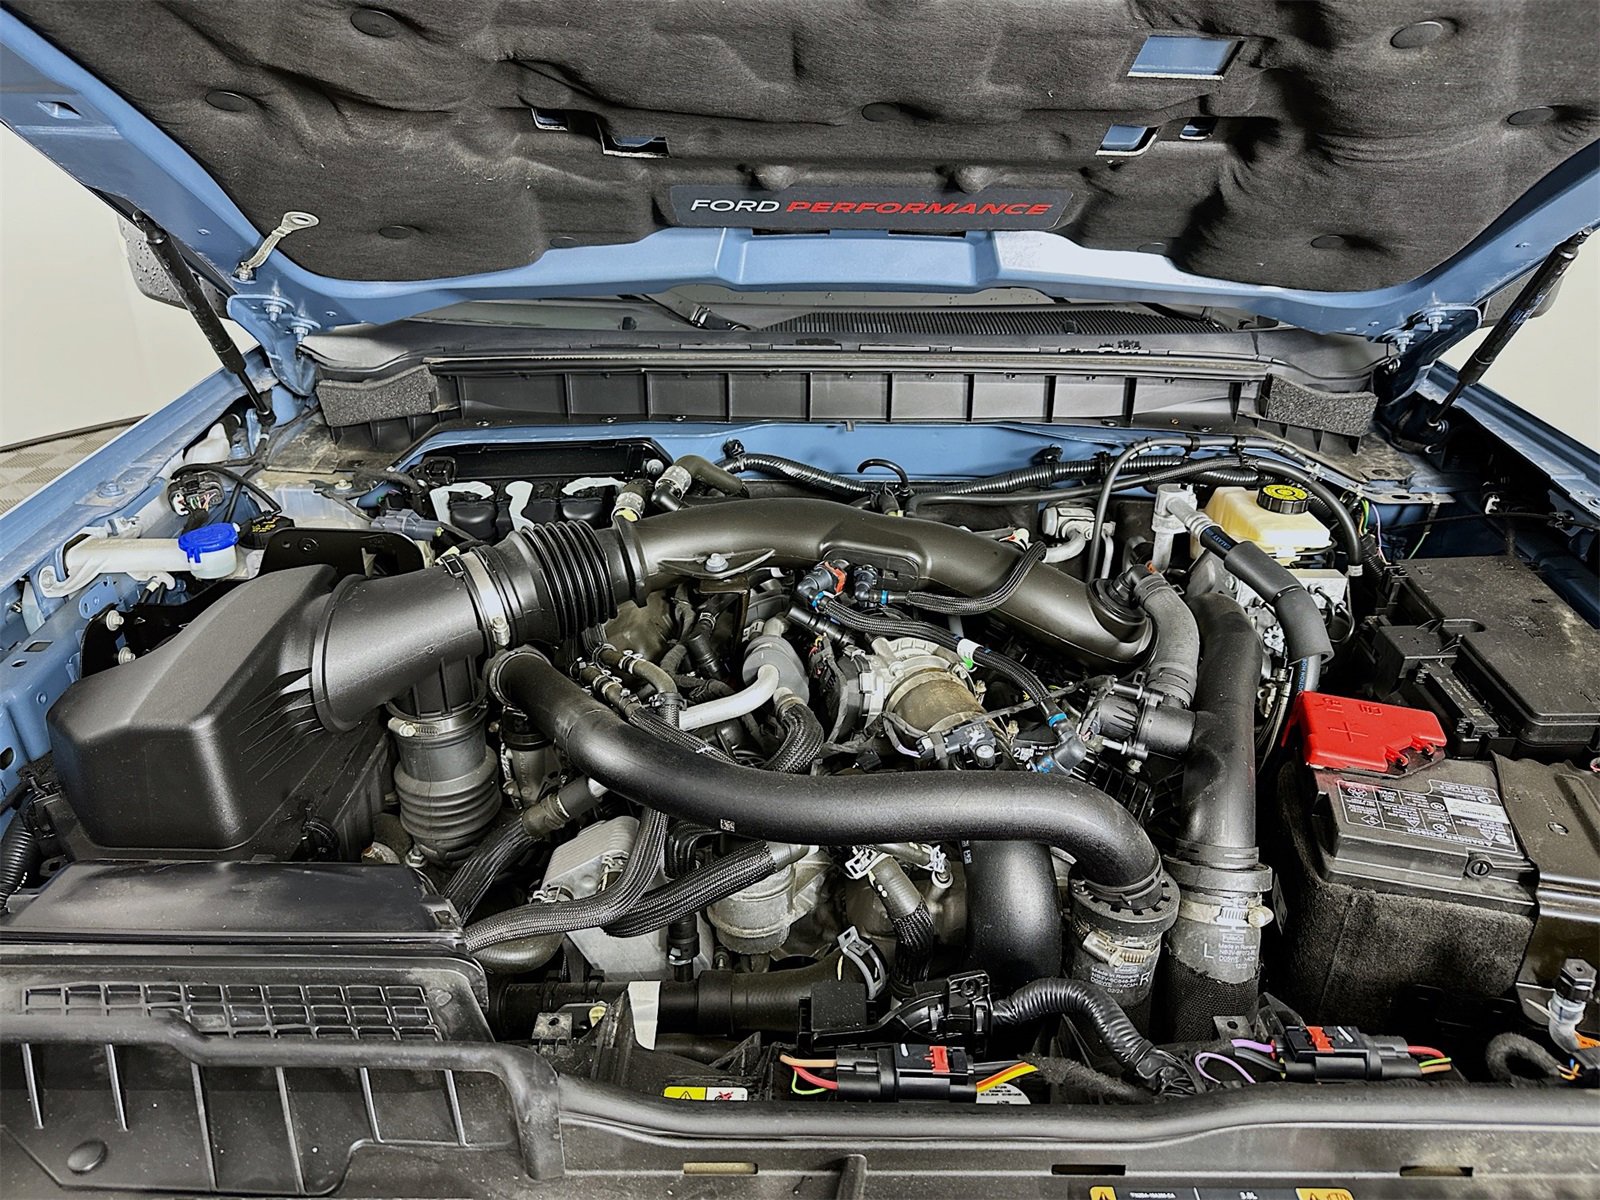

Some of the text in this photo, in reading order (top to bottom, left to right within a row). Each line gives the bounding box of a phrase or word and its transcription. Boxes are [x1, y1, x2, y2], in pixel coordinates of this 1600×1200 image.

[690, 199, 1053, 215] FORD PERFORMANCE
[1204, 942, 1214, 959] L
[1139, 970, 1151, 986] R
